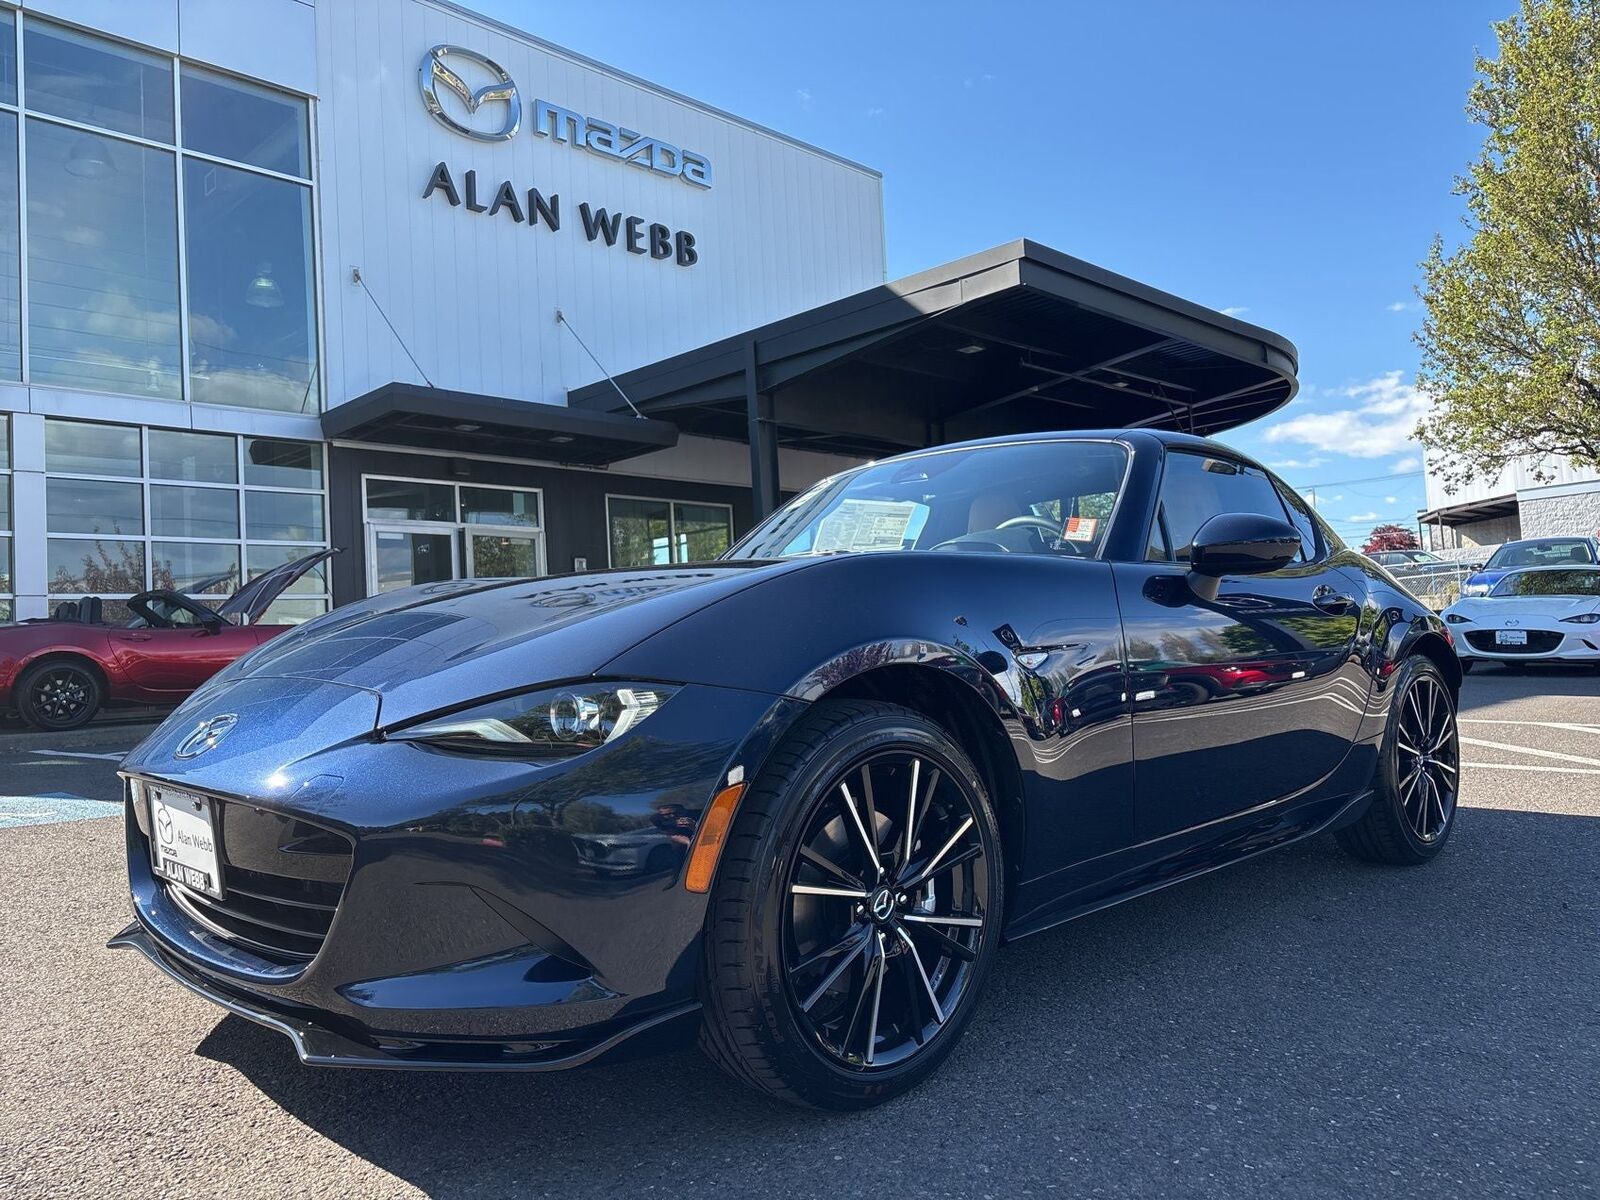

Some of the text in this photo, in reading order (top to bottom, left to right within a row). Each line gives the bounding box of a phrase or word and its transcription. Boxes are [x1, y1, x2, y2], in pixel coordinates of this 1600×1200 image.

[422, 161, 699, 267] ALAN WEBB
[177, 830, 213, 852] Alan Webb
[183, 866, 206, 891] WEBB
